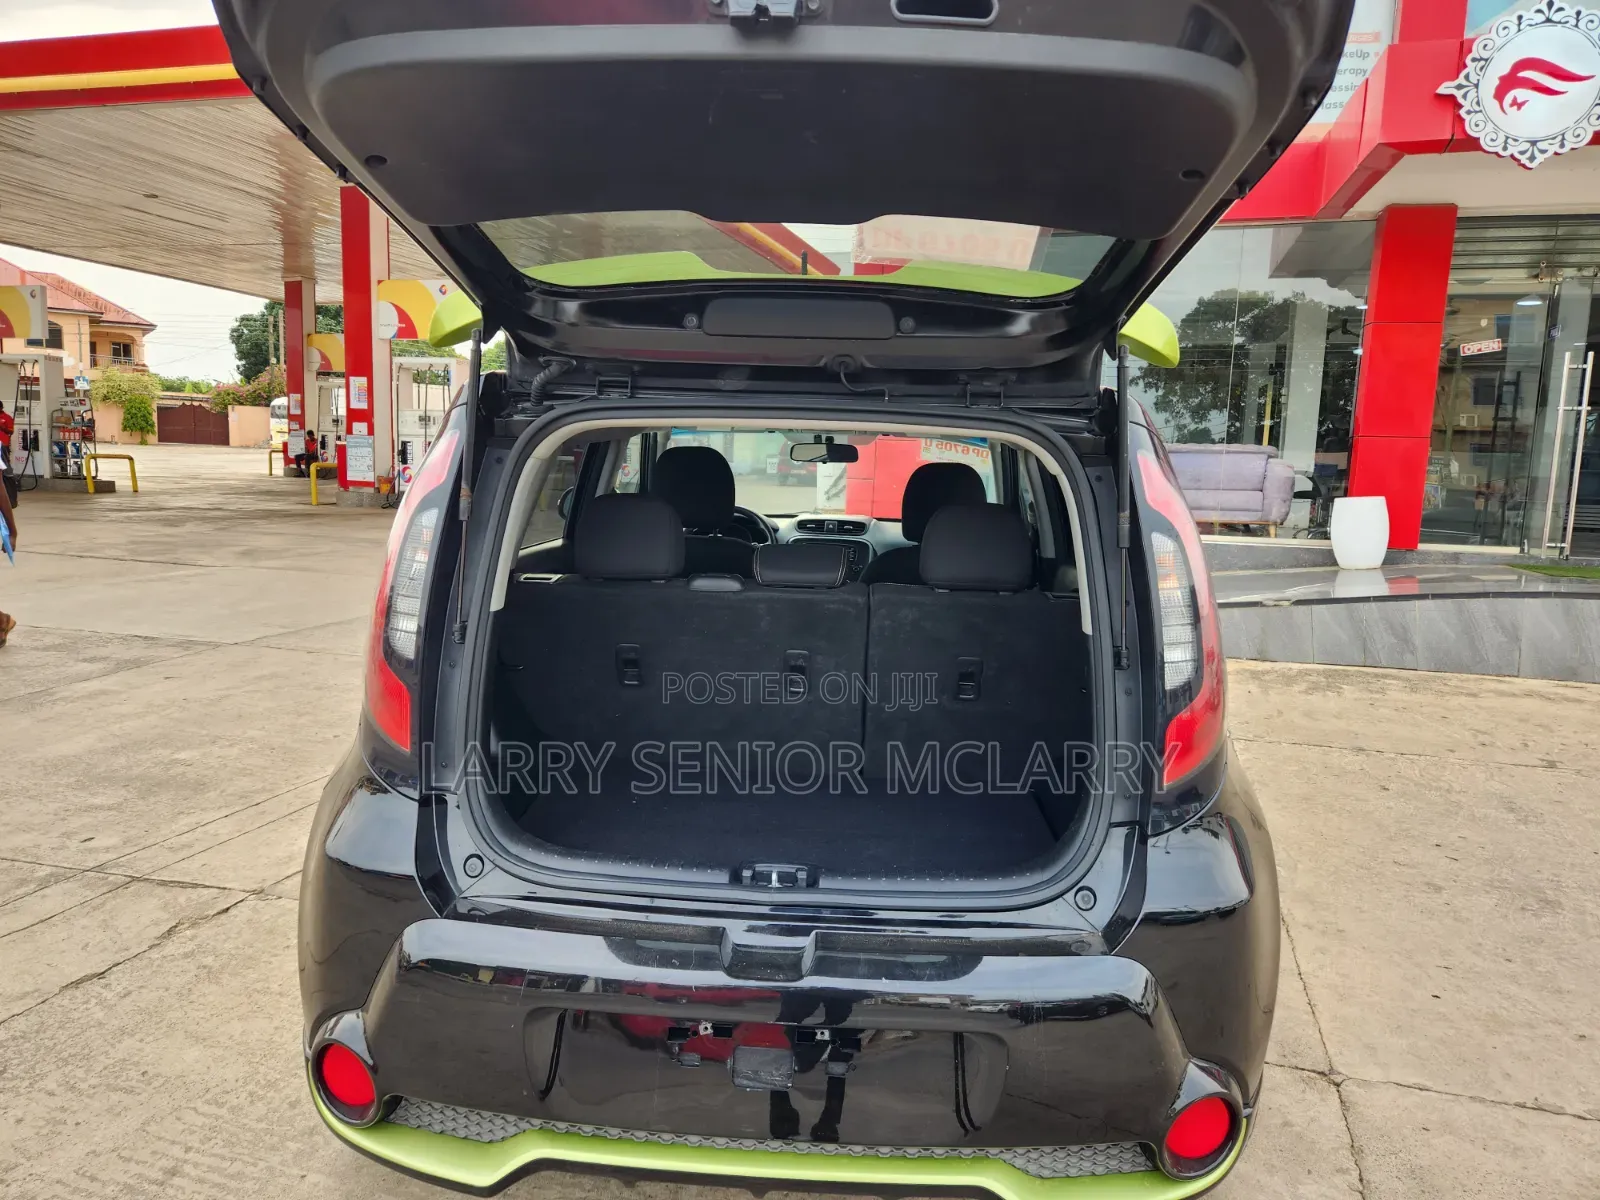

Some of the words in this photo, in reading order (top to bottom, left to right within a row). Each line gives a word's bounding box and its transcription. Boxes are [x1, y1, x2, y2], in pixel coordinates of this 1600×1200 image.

[1342, 49, 1370, 60] keUp
[1336, 67, 1368, 77] erapy
[1463, 341, 1498, 354] OPEN
